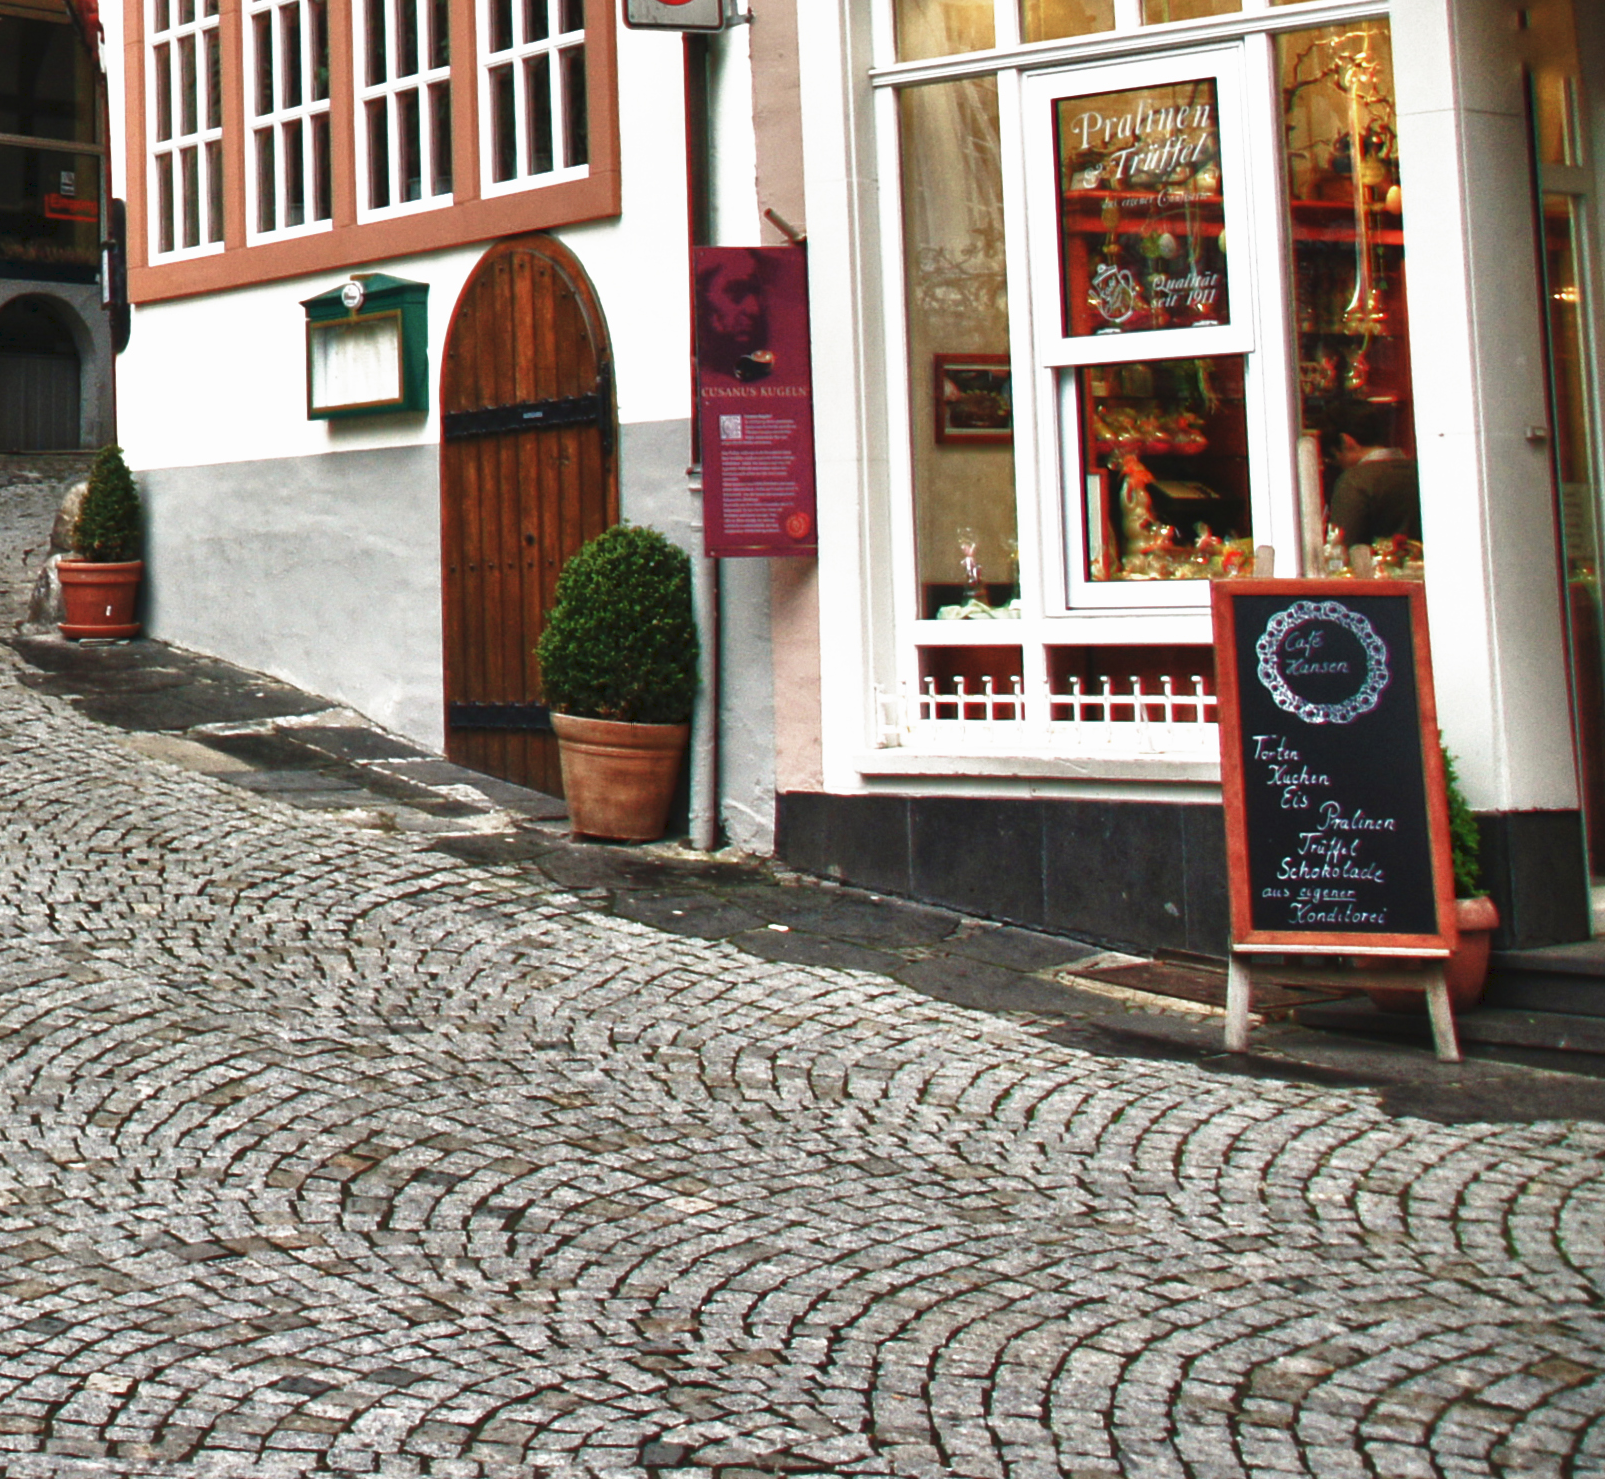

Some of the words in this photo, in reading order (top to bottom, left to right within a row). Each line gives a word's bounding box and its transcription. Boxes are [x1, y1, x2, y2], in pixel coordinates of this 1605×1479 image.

[1071, 100, 1210, 149] Pralinen
[1110, 133, 1207, 179] Trüffel
[701, 386, 756, 398] CUSANUS
[760, 386, 806, 397] KUGELN
[1285, 630, 1324, 657] Café
[1286, 658, 1349, 675] Hansen
[1252, 735, 1299, 760] Torten
[1267, 765, 1330, 785] Kuchen
[1281, 786, 1308, 809] Eis
[1317, 801, 1395, 831] Pralinen
[1298, 833, 1360, 863] Trüffel
[1277, 857, 1385, 883] Schokolade
[1262, 887, 1289, 897] aus
[1297, 887, 1357, 903] eigener
[1288, 903, 1387, 924] Konditorei
